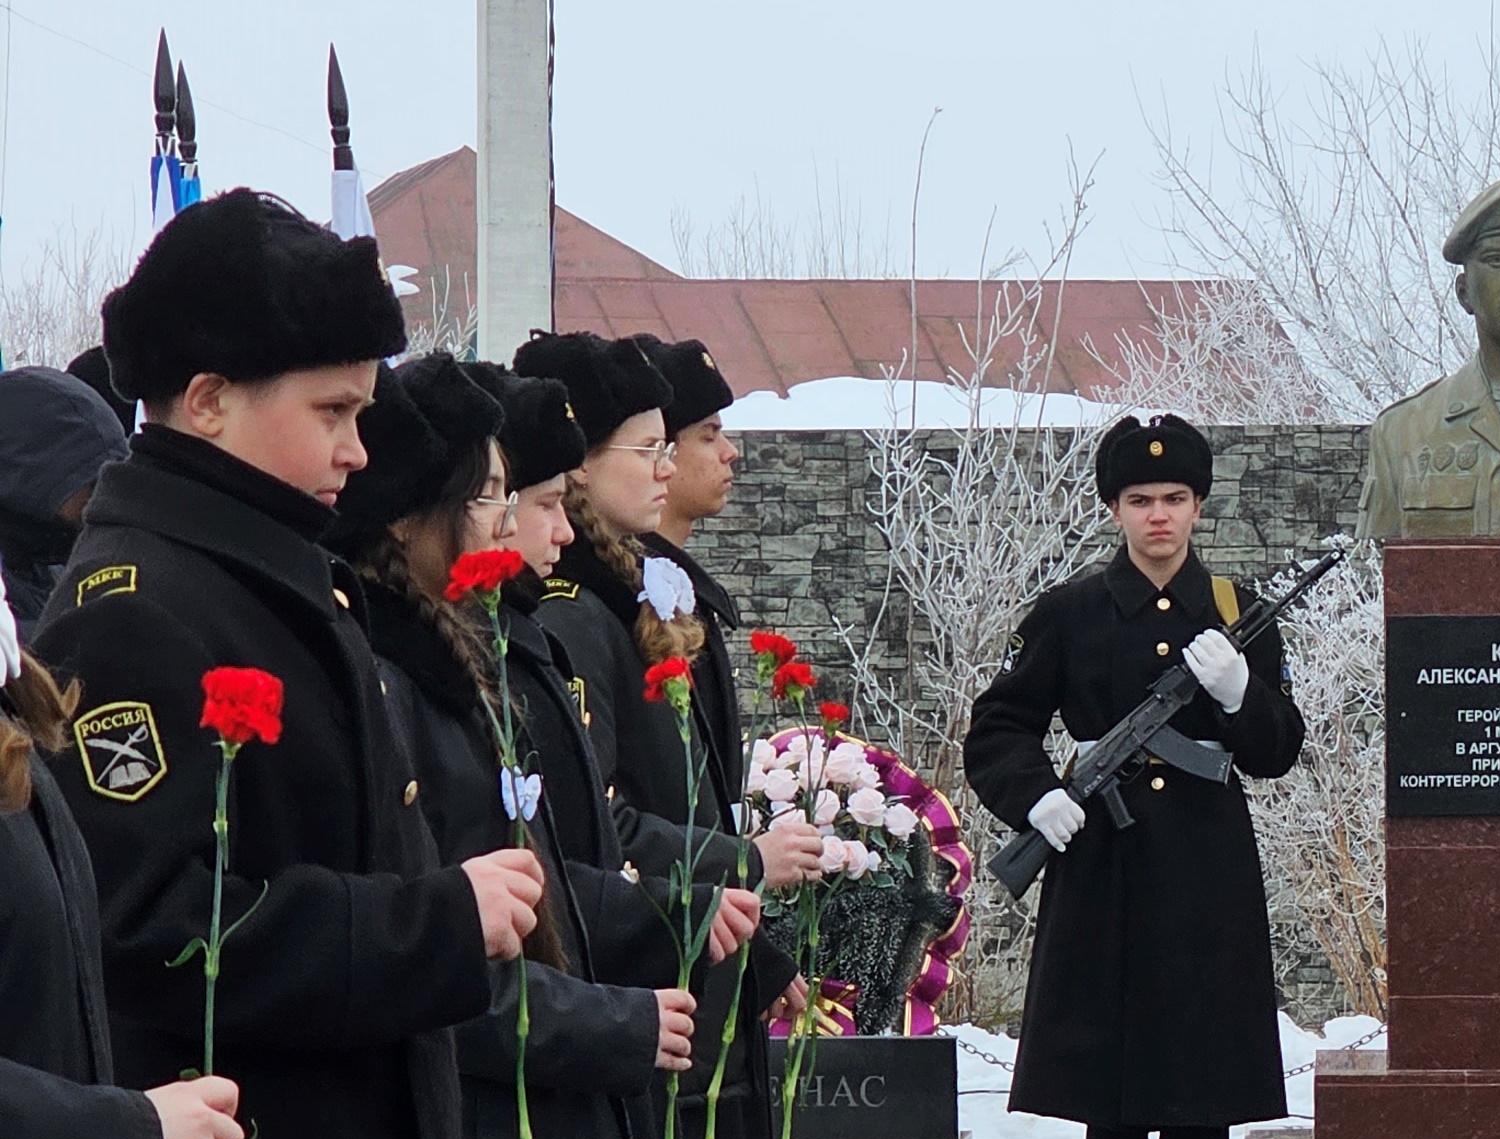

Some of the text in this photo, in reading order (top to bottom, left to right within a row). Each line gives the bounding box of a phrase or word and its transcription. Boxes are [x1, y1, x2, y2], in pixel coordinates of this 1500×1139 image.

[80, 708, 147, 738] РОССИЯ
[1484, 726, 1491, 738] 1
[1455, 742, 1466, 755] В
[1472, 758, 1500, 771] ПРИ
